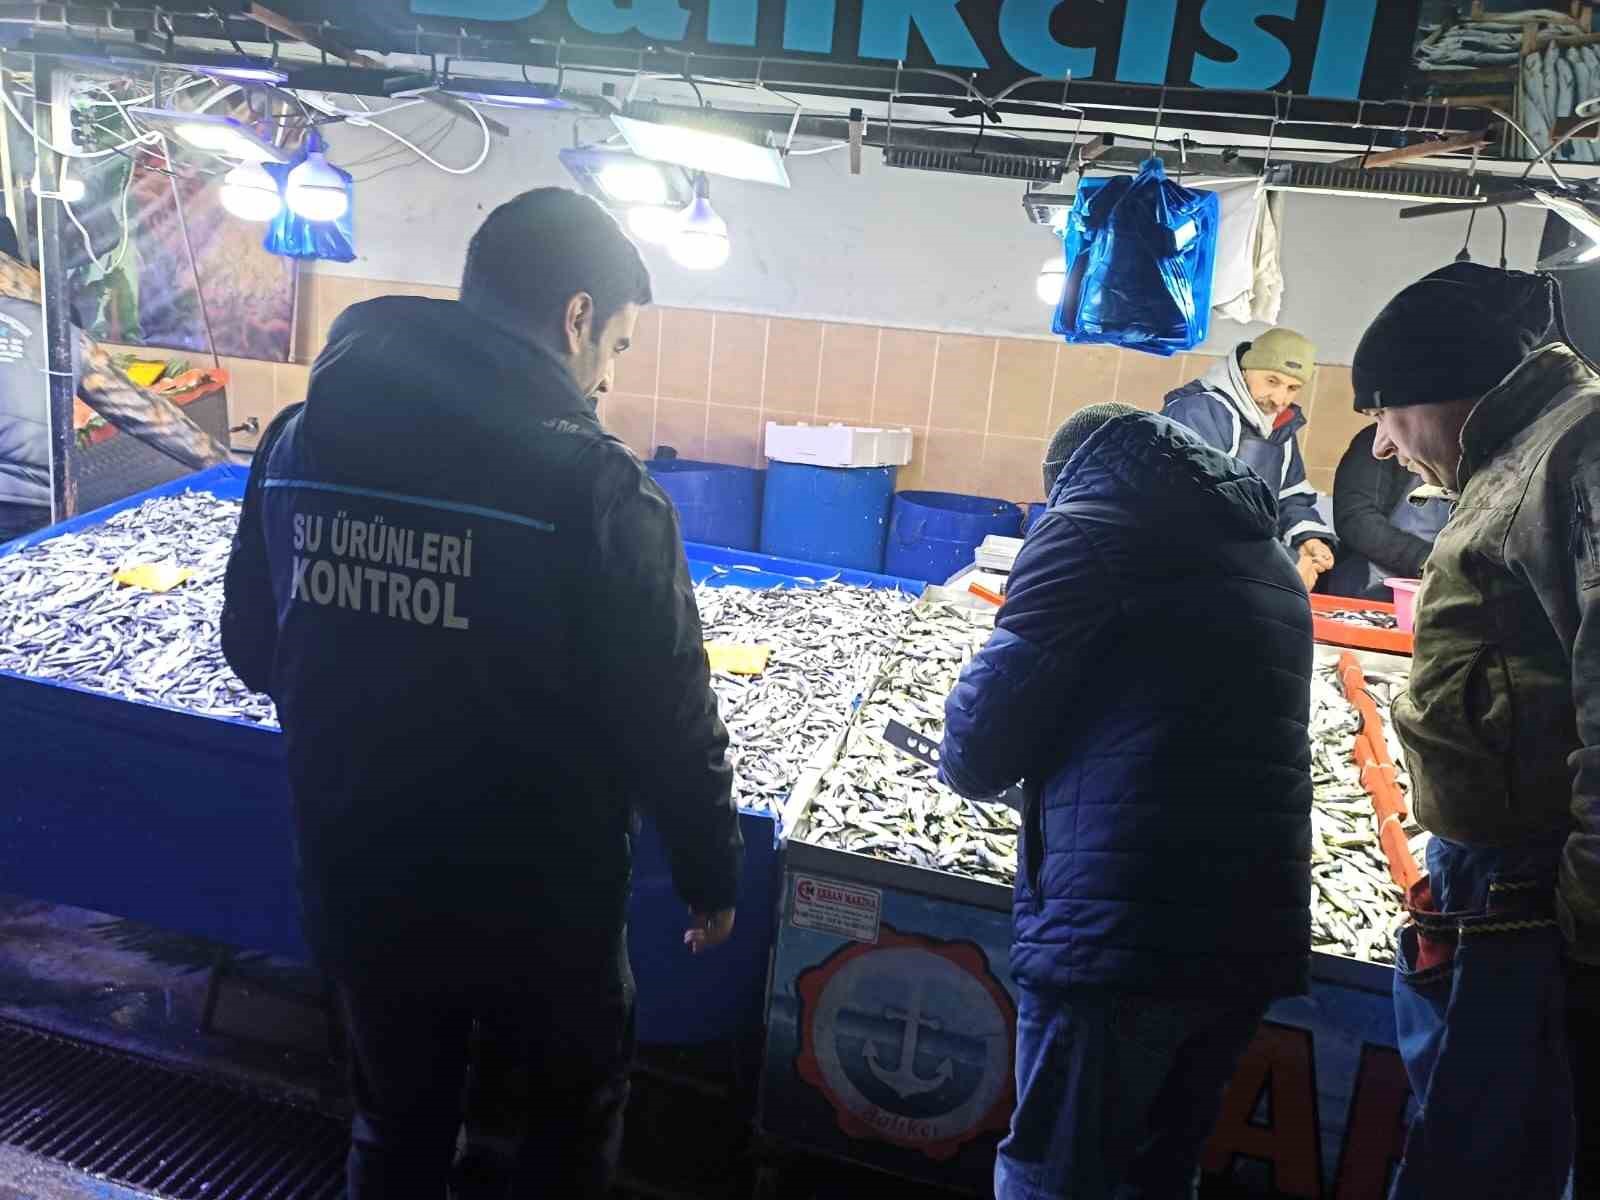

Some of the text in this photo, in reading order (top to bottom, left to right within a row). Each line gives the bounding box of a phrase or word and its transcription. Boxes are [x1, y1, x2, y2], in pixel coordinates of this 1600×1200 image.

[293, 510, 473, 577] SU ÜRÜNLERİ
[290, 555, 470, 630] KONTROL
